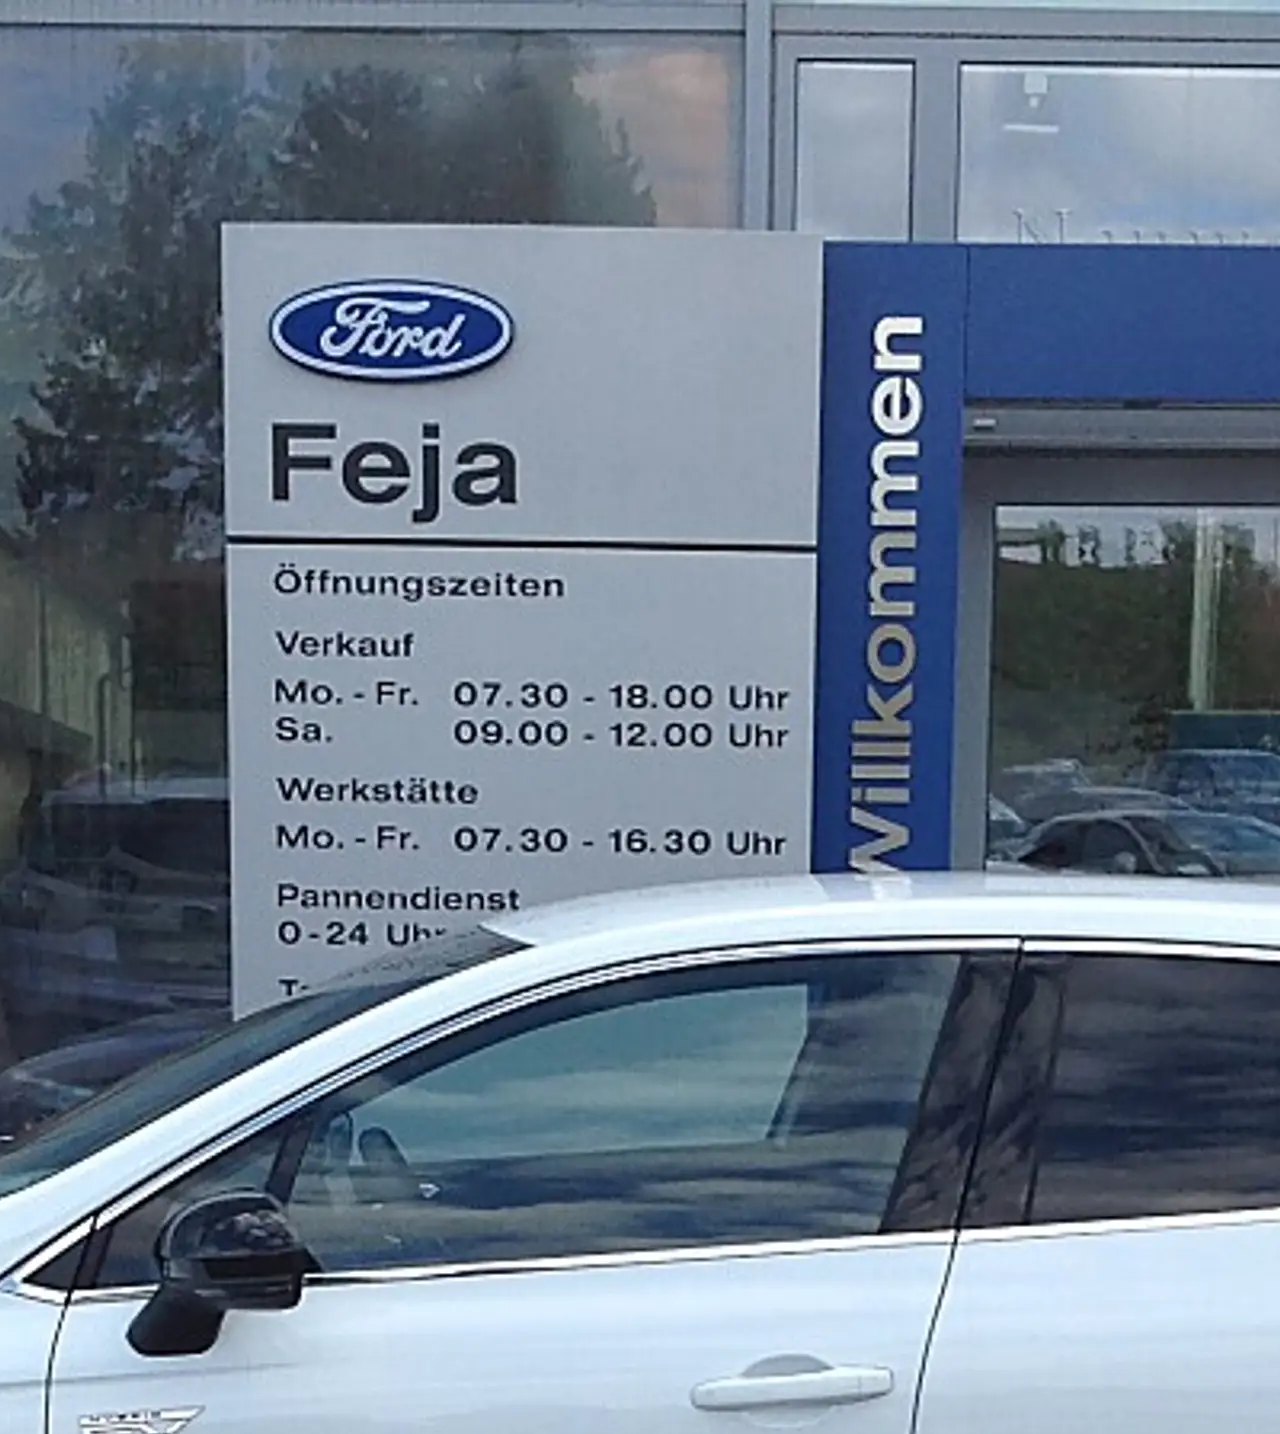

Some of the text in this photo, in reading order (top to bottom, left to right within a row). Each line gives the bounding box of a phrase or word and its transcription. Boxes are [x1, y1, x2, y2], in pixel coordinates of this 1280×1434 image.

[319, 297, 465, 359] Ford
[271, 423, 518, 523] Feja
[273, 563, 564, 601] Öffnungszeiten
[849, 315, 924, 874] Willkommen
[276, 630, 414, 659] Verkauf
[274, 682, 342, 706] Mo.
[376, 682, 419, 706] Fr.
[453, 682, 568, 708] 07.30
[610, 684, 713, 711] 18.00
[729, 685, 790, 712] Uhr
[275, 717, 332, 743] Sa.
[454, 721, 568, 747] 09.00
[610, 723, 713, 749] 12.00
[729, 724, 790, 750] Uhr
[277, 776, 478, 805] Werkstätte
[276, 826, 344, 850] Mo.
[377, 826, 420, 851] Fr.
[454, 828, 567, 853] 07.30
[610, 830, 712, 855] 16.30
[728, 831, 787, 857] Uhr
[278, 883, 520, 911] Pannendienst
